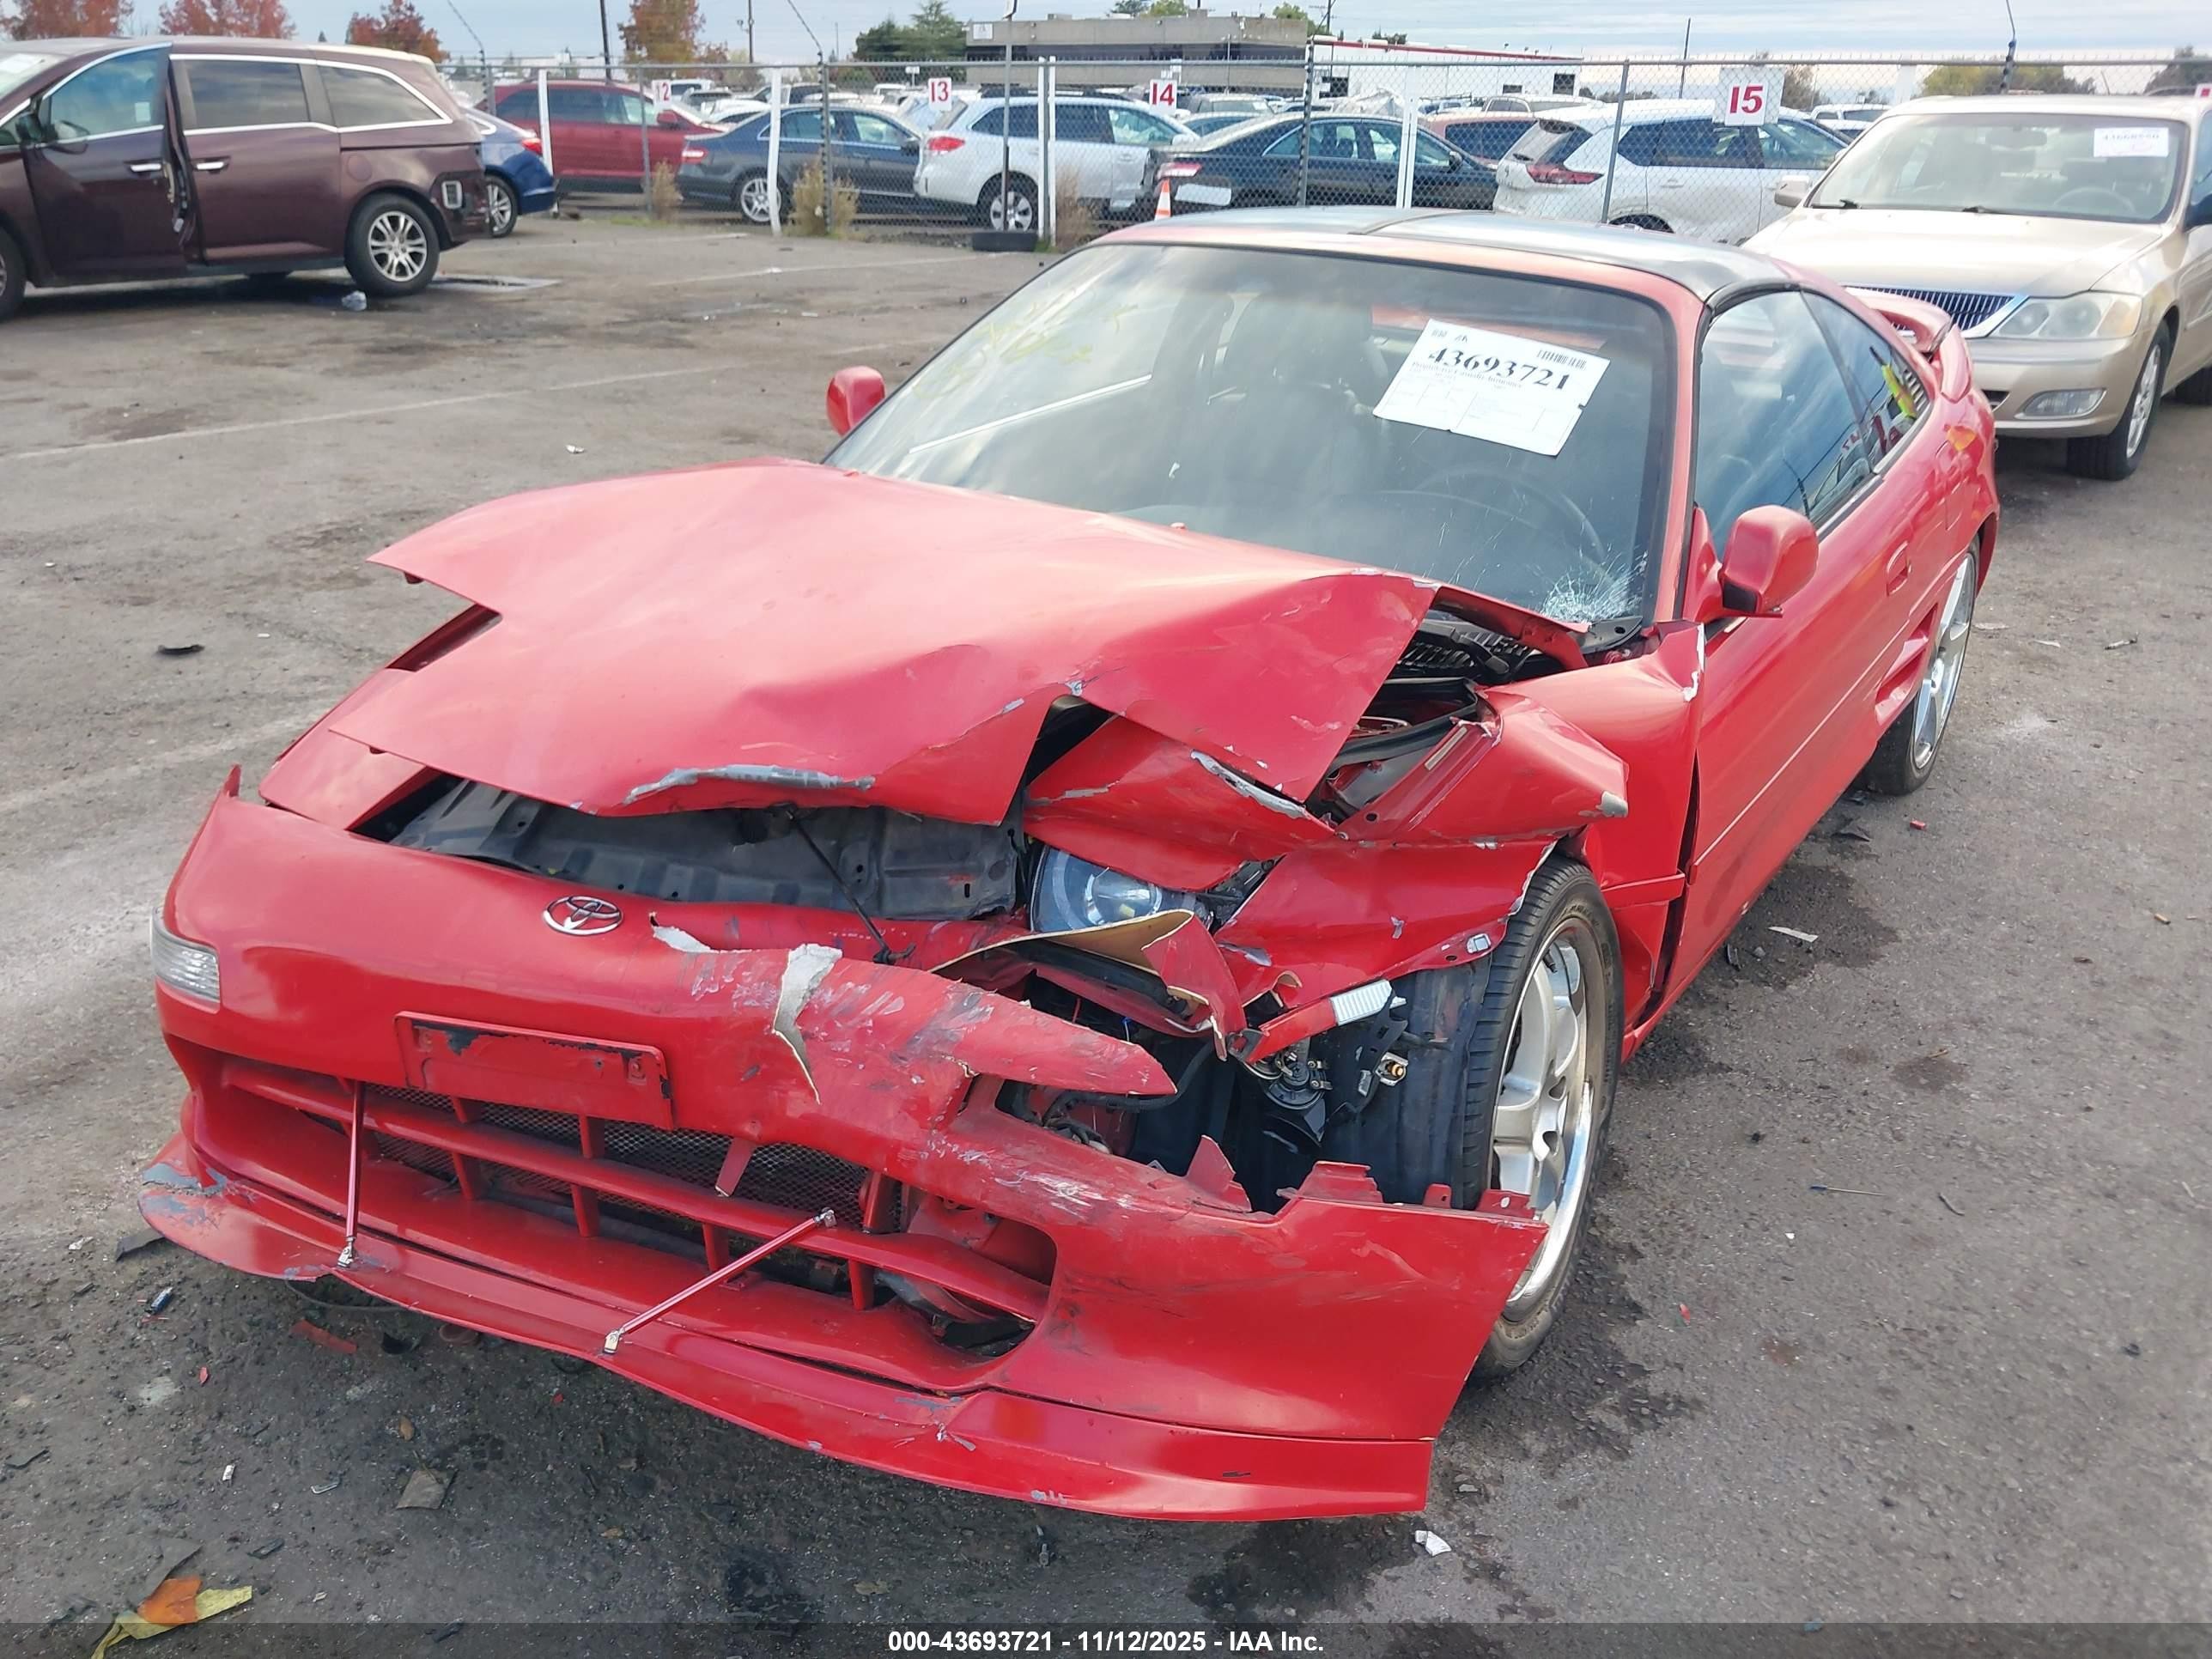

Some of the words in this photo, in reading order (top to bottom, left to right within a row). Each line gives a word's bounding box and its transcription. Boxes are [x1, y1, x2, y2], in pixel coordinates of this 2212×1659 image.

[931, 81, 949, 102] 13
[1152, 82, 1175, 106] 14
[1729, 85, 1764, 114] 15
[1428, 347, 1571, 390] 43693721
